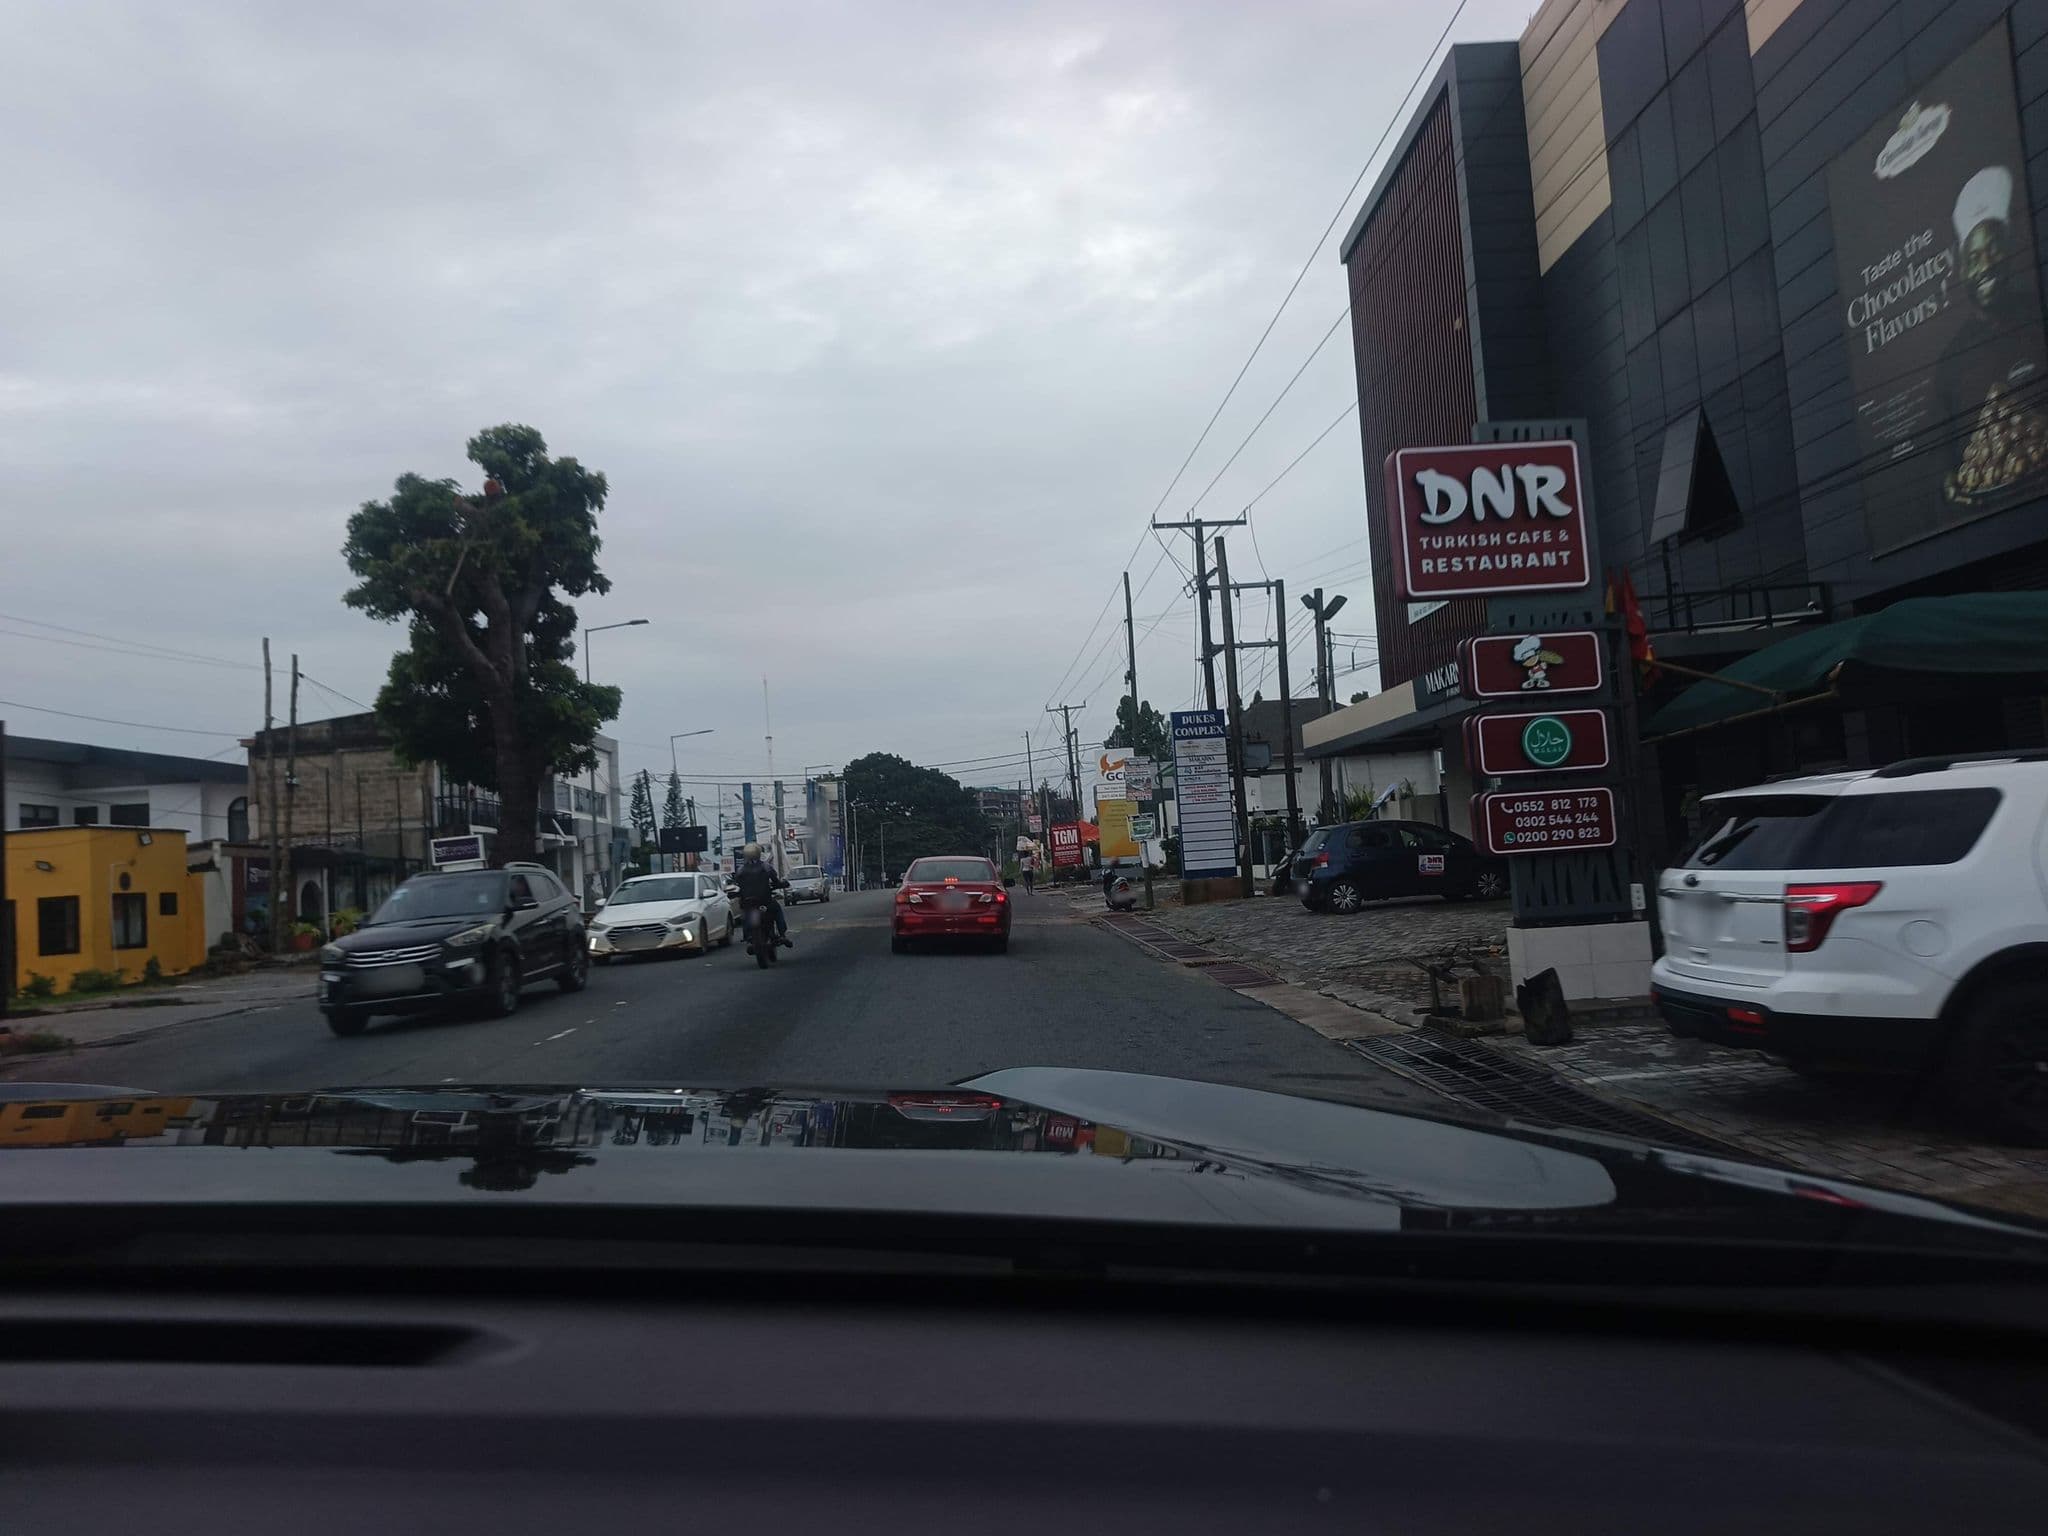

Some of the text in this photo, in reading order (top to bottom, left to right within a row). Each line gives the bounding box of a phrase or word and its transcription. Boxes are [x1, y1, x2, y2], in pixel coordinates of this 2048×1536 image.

[1860, 228, 1933, 287] Taste the
[1846, 247, 1954, 329] Chocolatey
[1415, 463, 1573, 525] DNR
[1419, 529, 1570, 550] TURKISH CAFE &
[1421, 550, 1572, 574] RESTAURANT
[1181, 713, 1216, 725] DUKES
[1174, 724, 1225, 737] COMPLEX
[1530, 729, 1565, 748] حلال
[1106, 771, 1126, 781] GC
[1514, 797, 1598, 812] 0552 812 173
[1515, 812, 1600, 827] 0302 544 244
[1053, 829, 1079, 845] TGM
[1517, 827, 1601, 843] 0200 290 823
